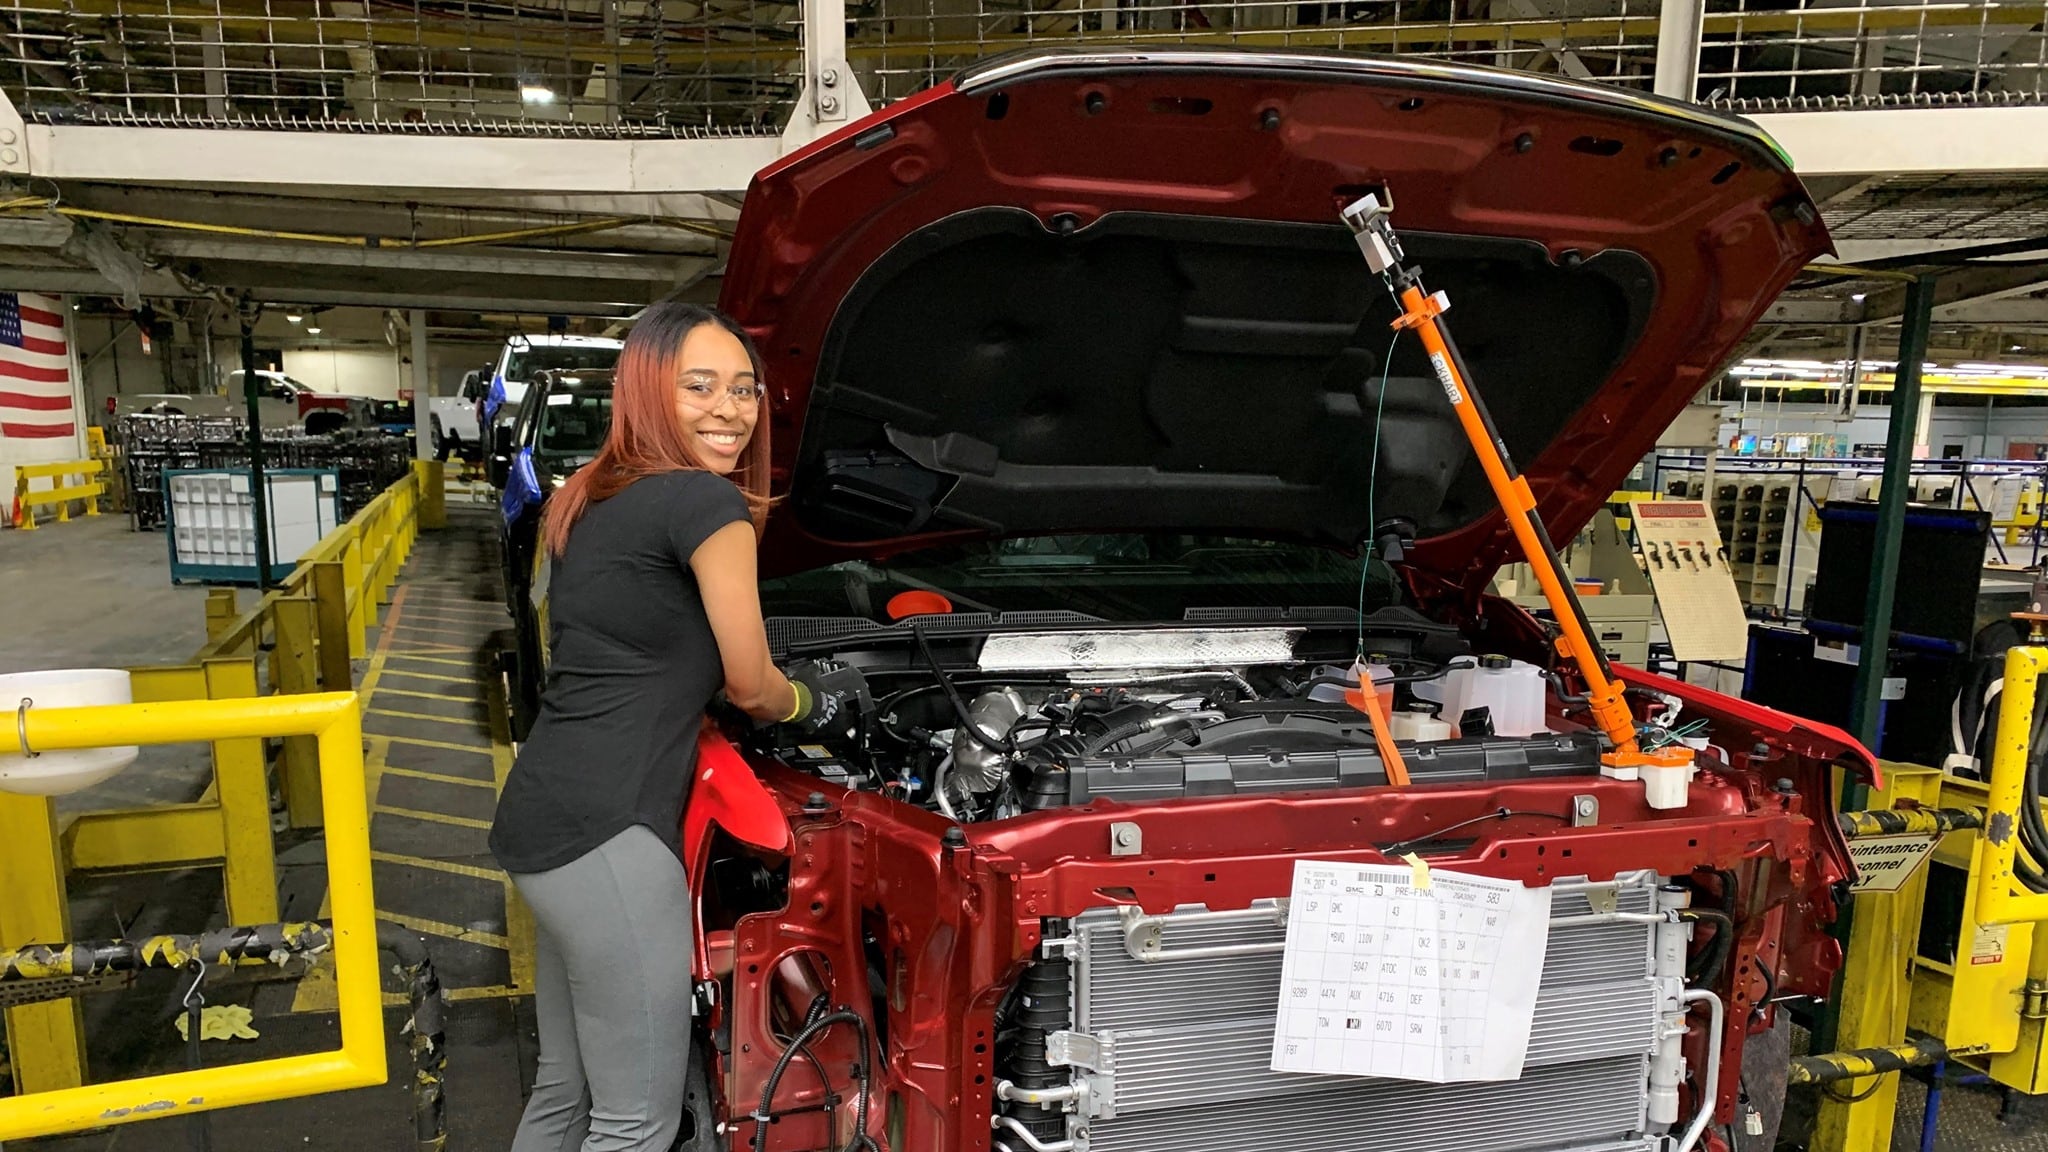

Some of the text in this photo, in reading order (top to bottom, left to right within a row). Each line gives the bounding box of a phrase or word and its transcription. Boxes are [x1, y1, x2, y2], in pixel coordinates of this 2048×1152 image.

[1430, 353, 1462, 404] ECKHART
[1848, 843, 1928, 856] aintenance
[1857, 858, 1906, 871] sonnel
[1313, 879, 1326, 890] 207
[1852, 874, 1877, 887] LY
[1345, 886, 1364, 894] GMC
[1395, 886, 1436, 898] PRE-FINAL
[1391, 906, 1400, 917] 43
[1321, 988, 1336, 999] 4474
[1378, 991, 1395, 1003] 4716
[1410, 994, 1423, 1005] DEF
